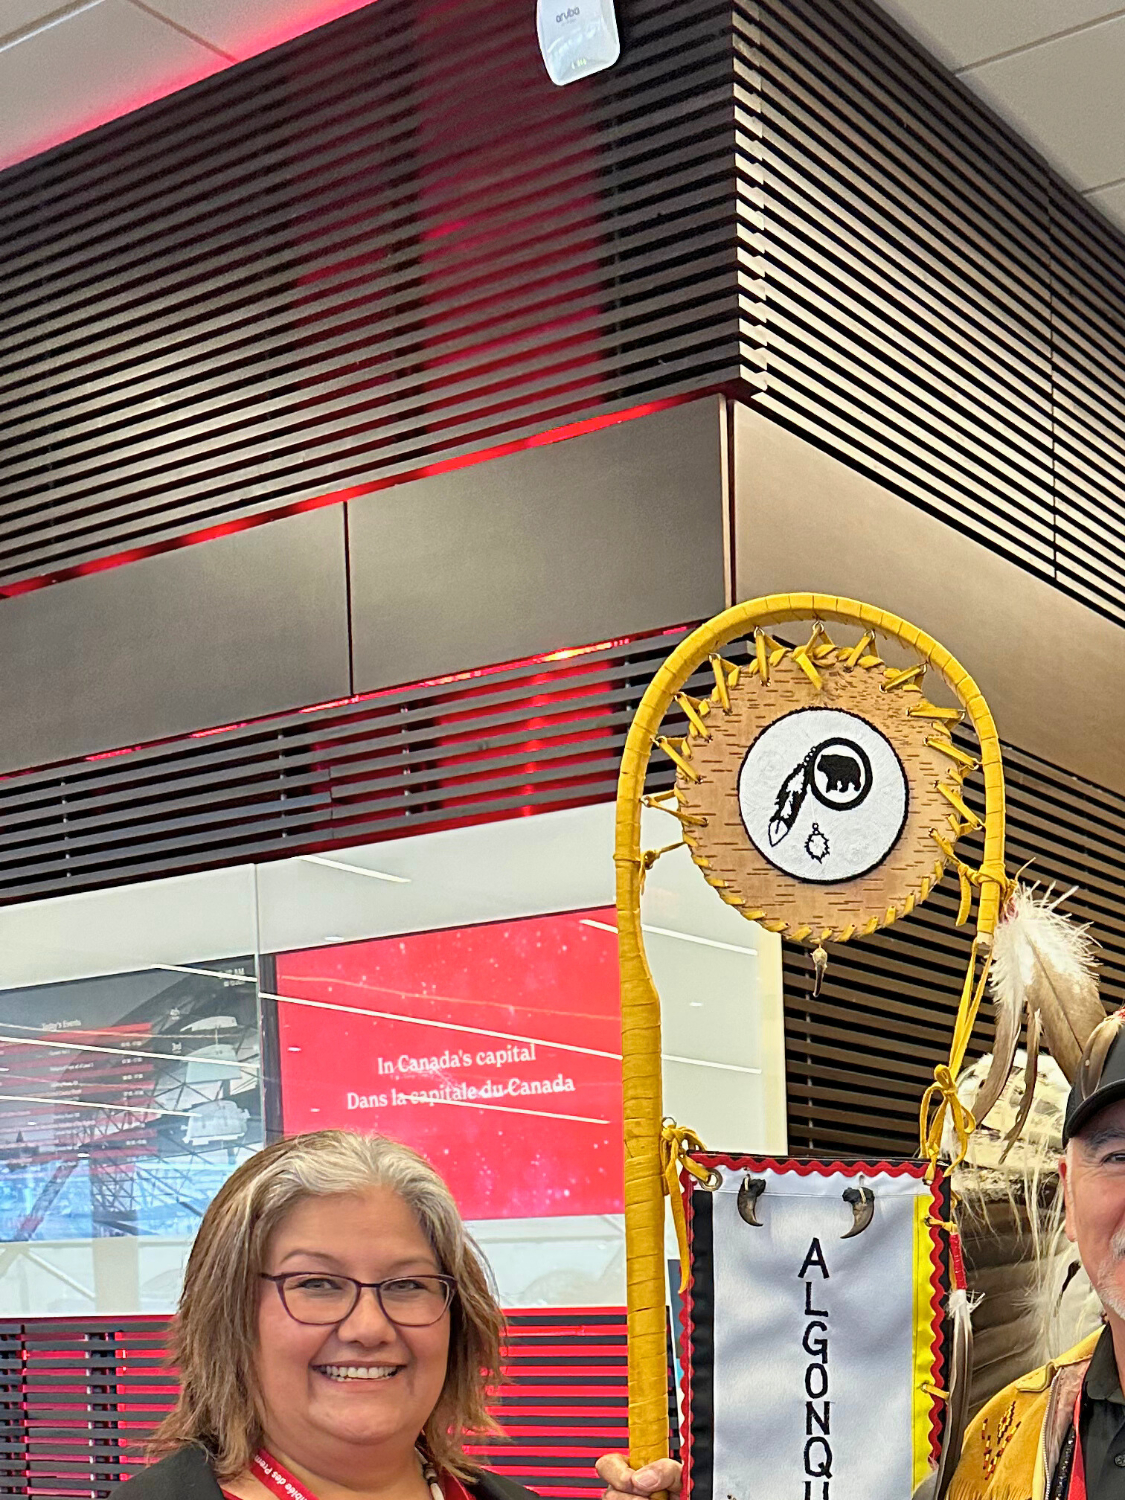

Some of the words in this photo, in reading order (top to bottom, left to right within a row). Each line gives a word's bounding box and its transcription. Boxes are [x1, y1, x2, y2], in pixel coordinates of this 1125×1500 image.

[555, 6, 580, 23] aruba
[377, 1057, 394, 1074] In
[398, 1050, 473, 1073] Canada's
[476, 1043, 537, 1067] capital
[347, 1092, 388, 1110] Dans
[391, 1088, 407, 1106] la
[410, 1082, 477, 1107] capitale
[482, 1080, 505, 1098] du
[507, 1073, 576, 1096] Canada
[272, 1471, 287, 1486] des
